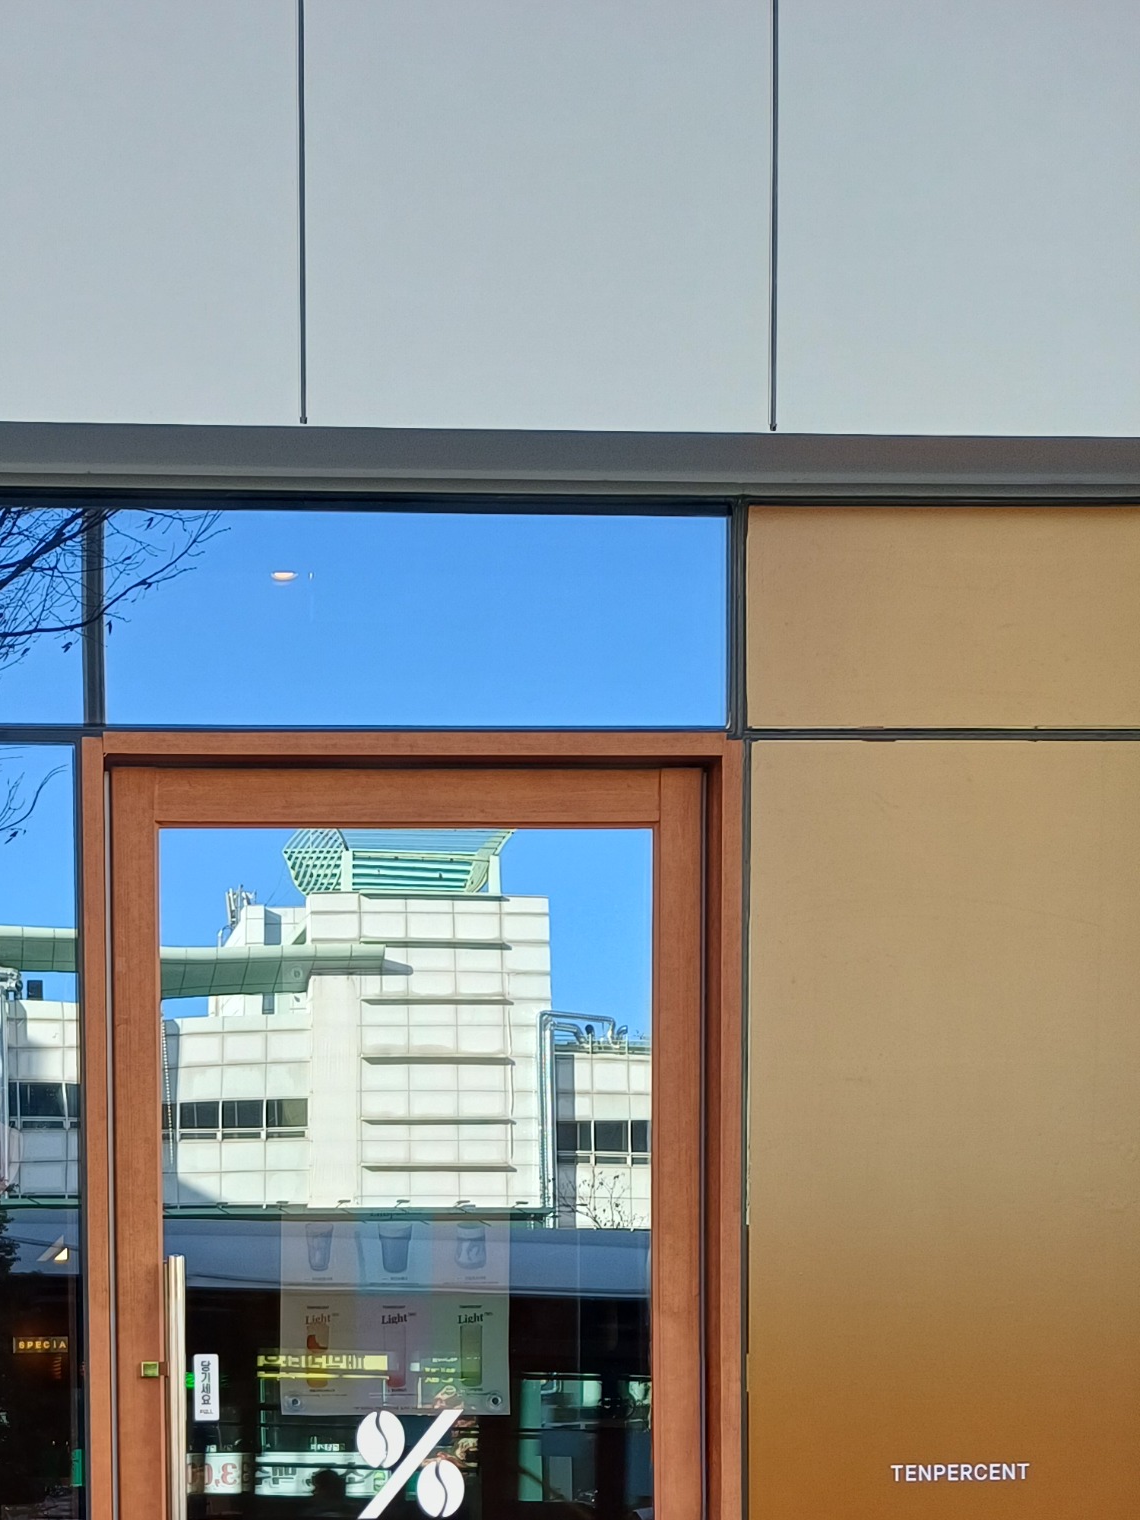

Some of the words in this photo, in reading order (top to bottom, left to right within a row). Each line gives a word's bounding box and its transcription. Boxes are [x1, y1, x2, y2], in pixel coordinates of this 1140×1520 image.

[305, 1313, 330, 1325] Light
[381, 1314, 407, 1325] Light
[458, 1314, 483, 1325] Light
[201, 1360, 211, 1405] 당기세요
[891, 1463, 1029, 1482] TENPERCENT
